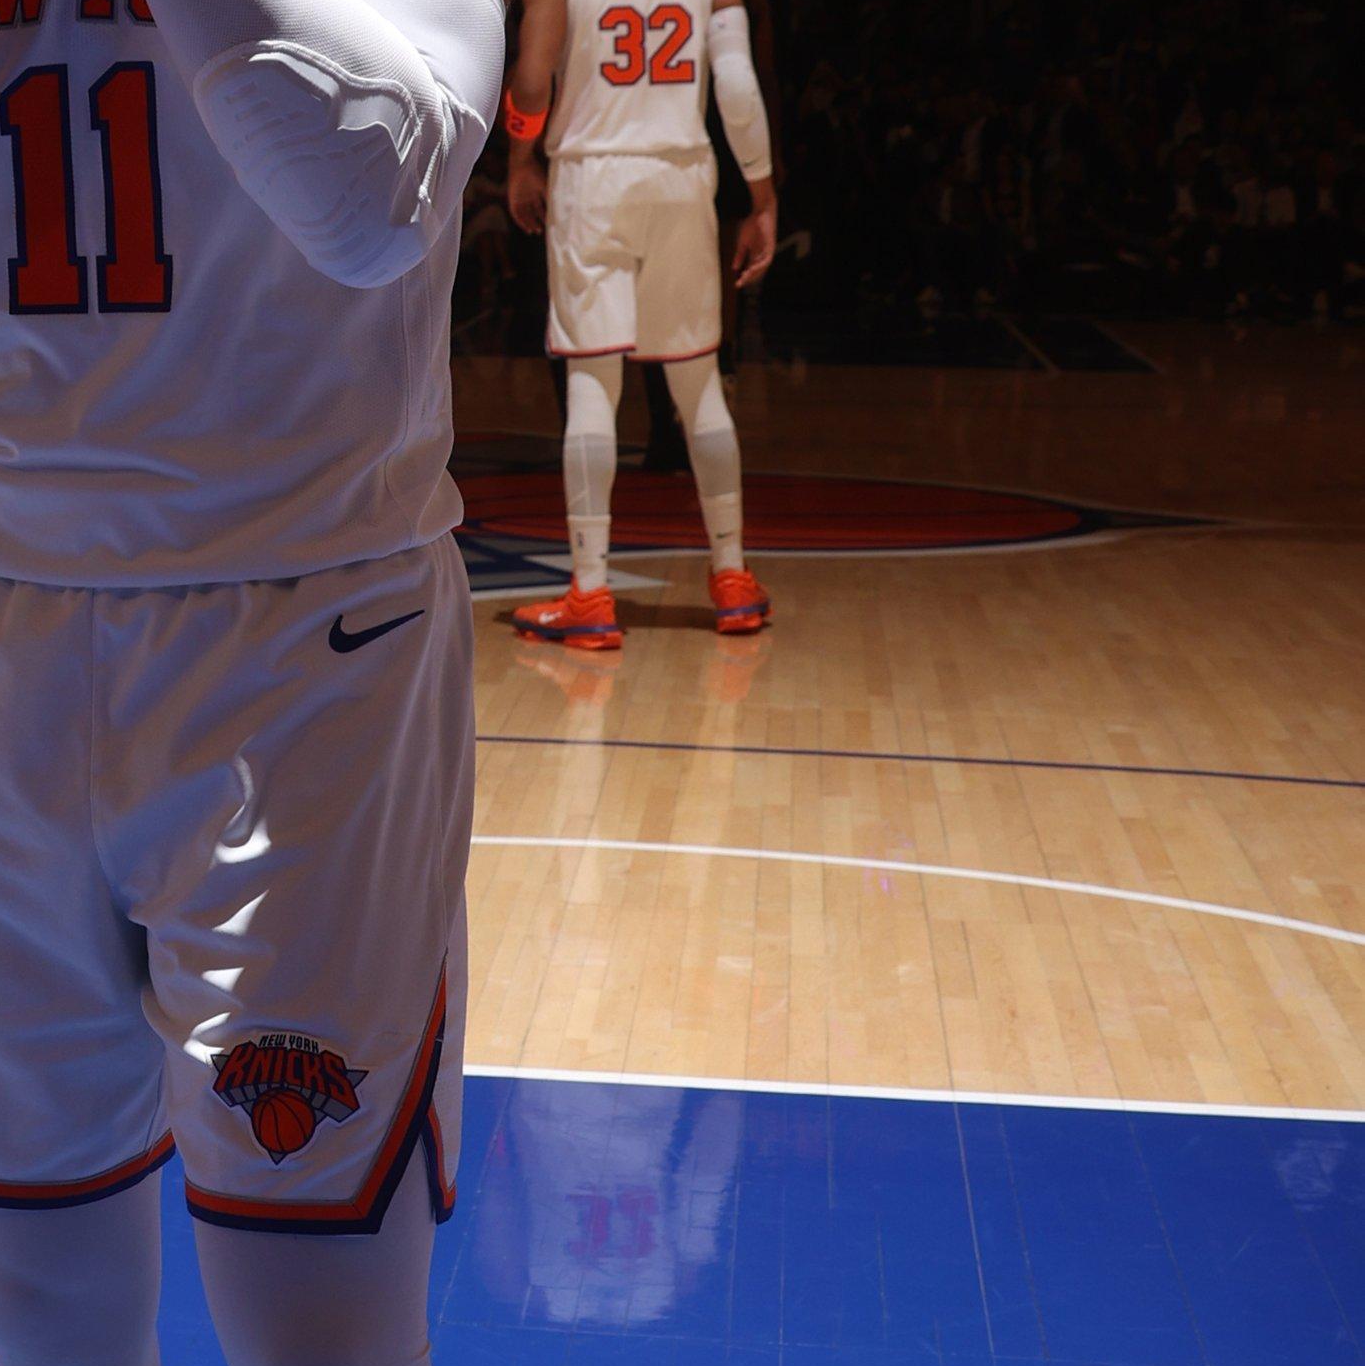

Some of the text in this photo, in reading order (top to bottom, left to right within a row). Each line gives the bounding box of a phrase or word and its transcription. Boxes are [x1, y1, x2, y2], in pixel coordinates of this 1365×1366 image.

[598, 4, 695, 86] 32
[213, 1041, 361, 1112] KNICKS
[258, 1034, 320, 1053] NEW YORK
